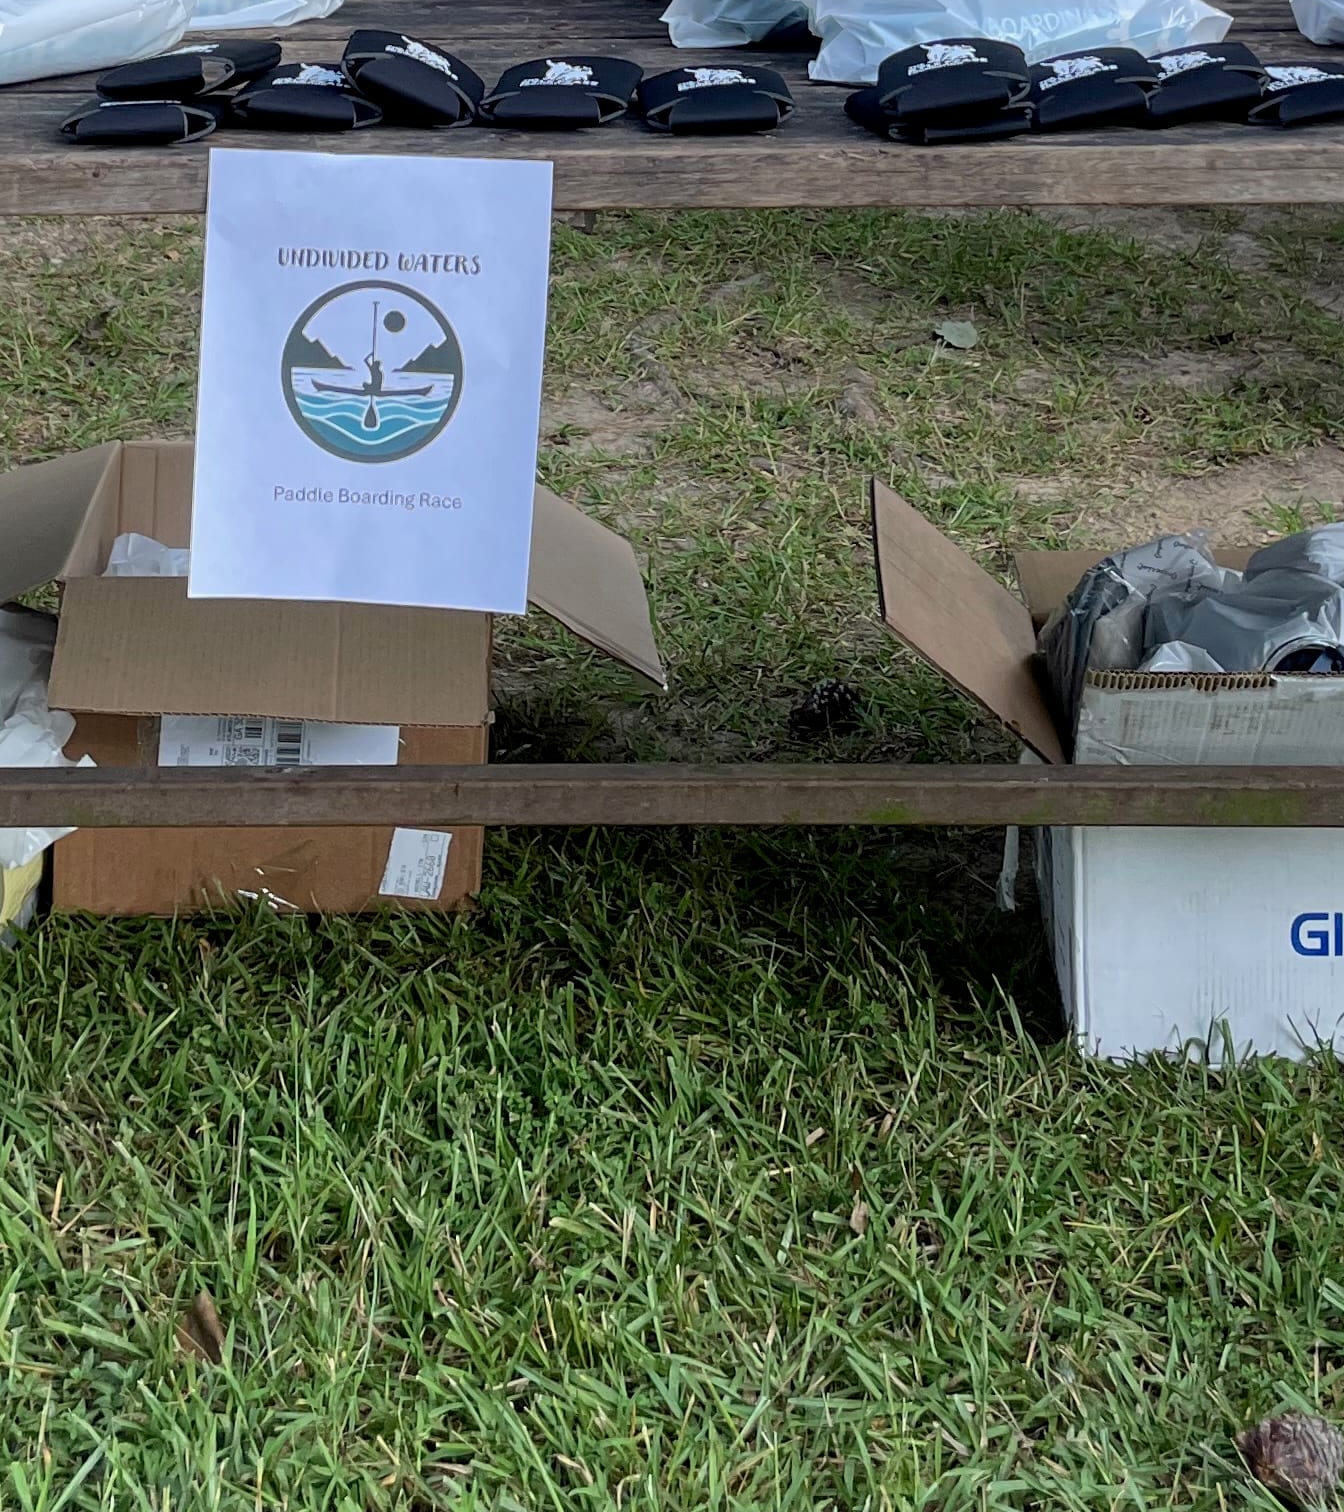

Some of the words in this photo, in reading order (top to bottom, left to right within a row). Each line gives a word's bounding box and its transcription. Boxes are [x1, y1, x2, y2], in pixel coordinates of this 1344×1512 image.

[277, 246, 389, 272] UNDIVIDED
[398, 252, 482, 276] WATERS
[273, 485, 334, 505] Paddle
[338, 487, 415, 510] Boarding
[419, 492, 463, 510] Race
